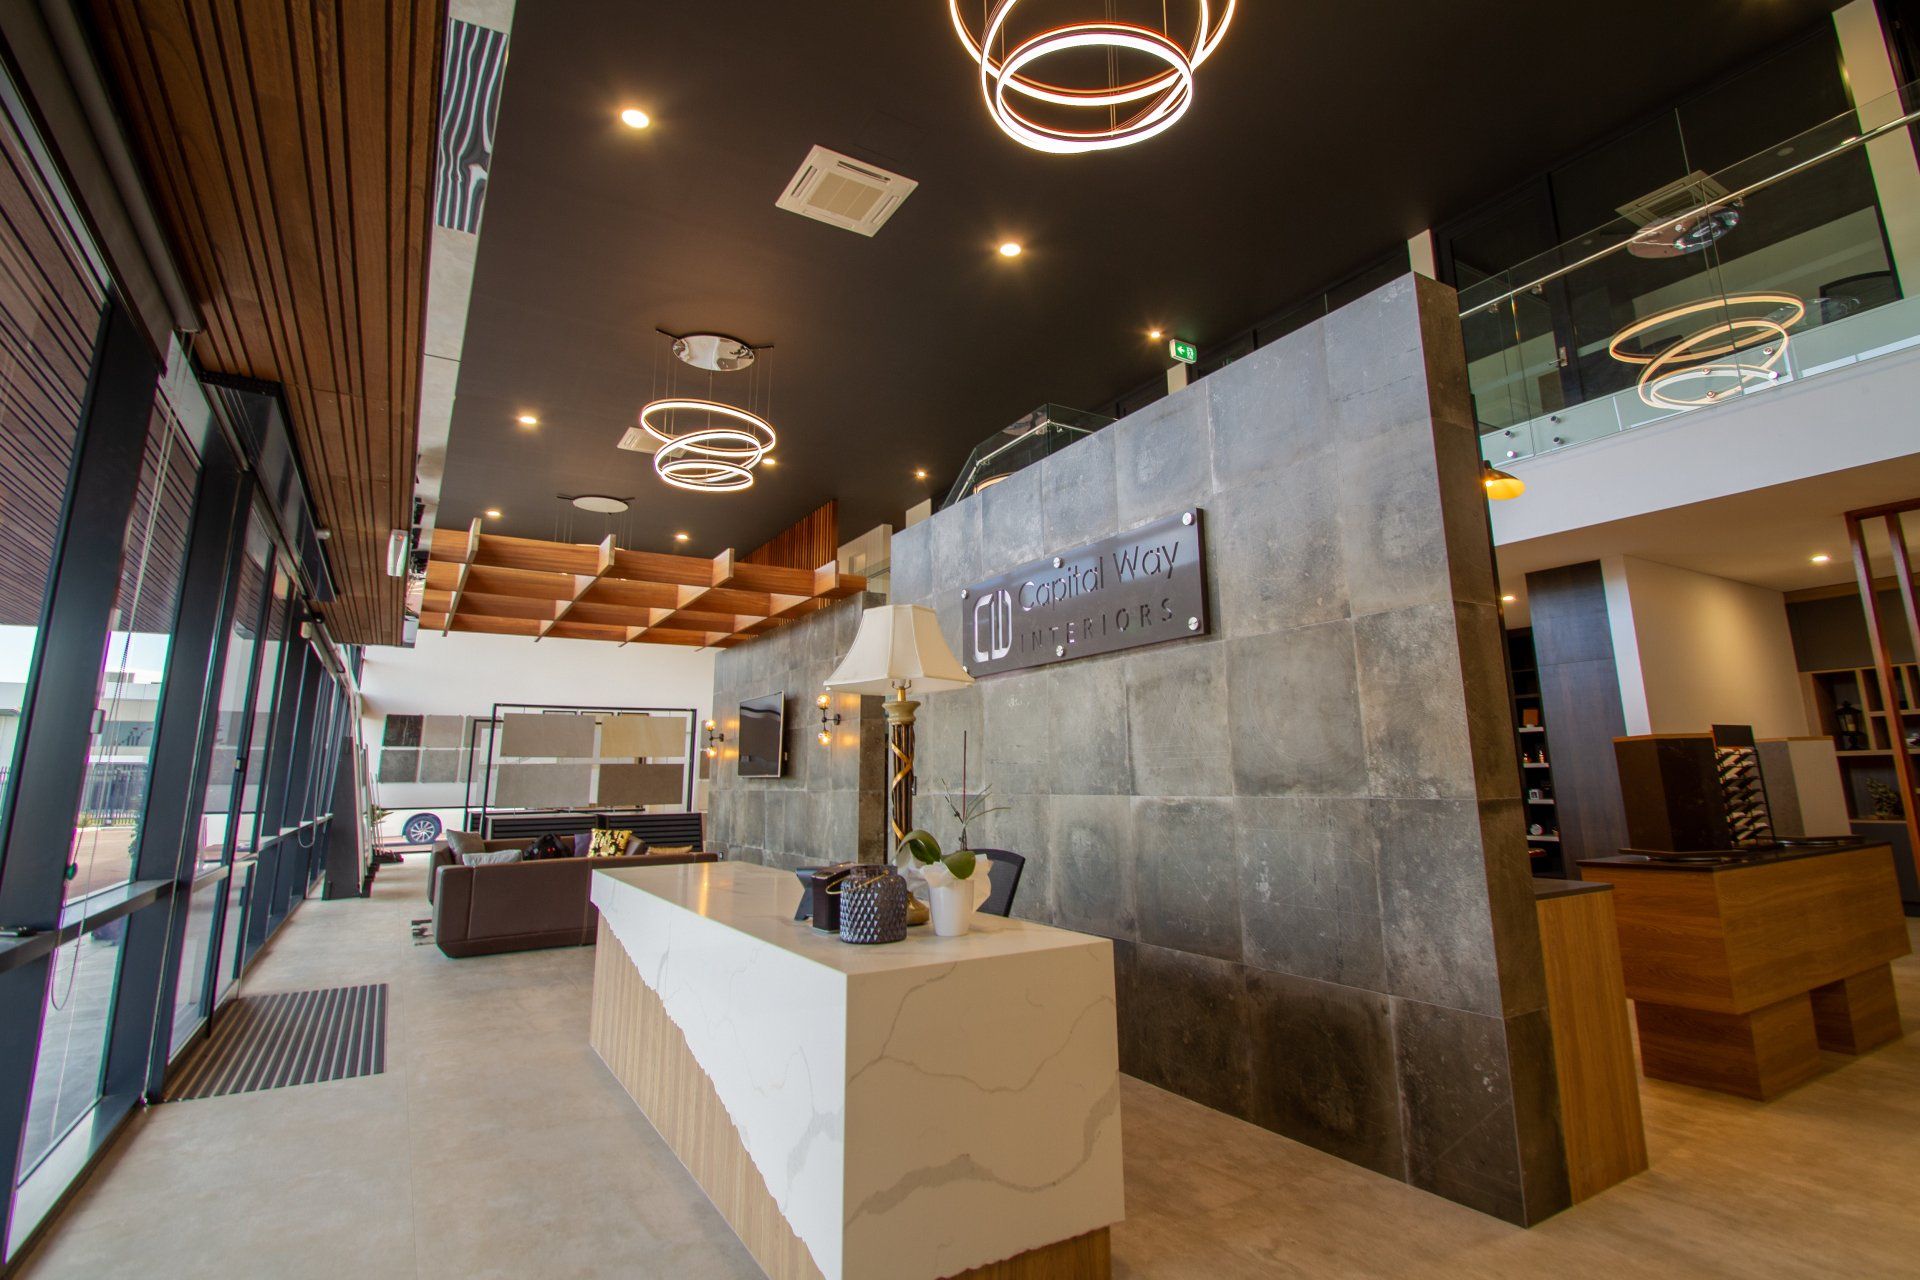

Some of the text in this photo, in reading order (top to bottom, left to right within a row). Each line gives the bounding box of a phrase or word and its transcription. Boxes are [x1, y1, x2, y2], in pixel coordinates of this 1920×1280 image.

[1018, 542, 1179, 611] Capital Way
[1020, 598, 1173, 652] INTERIORS
